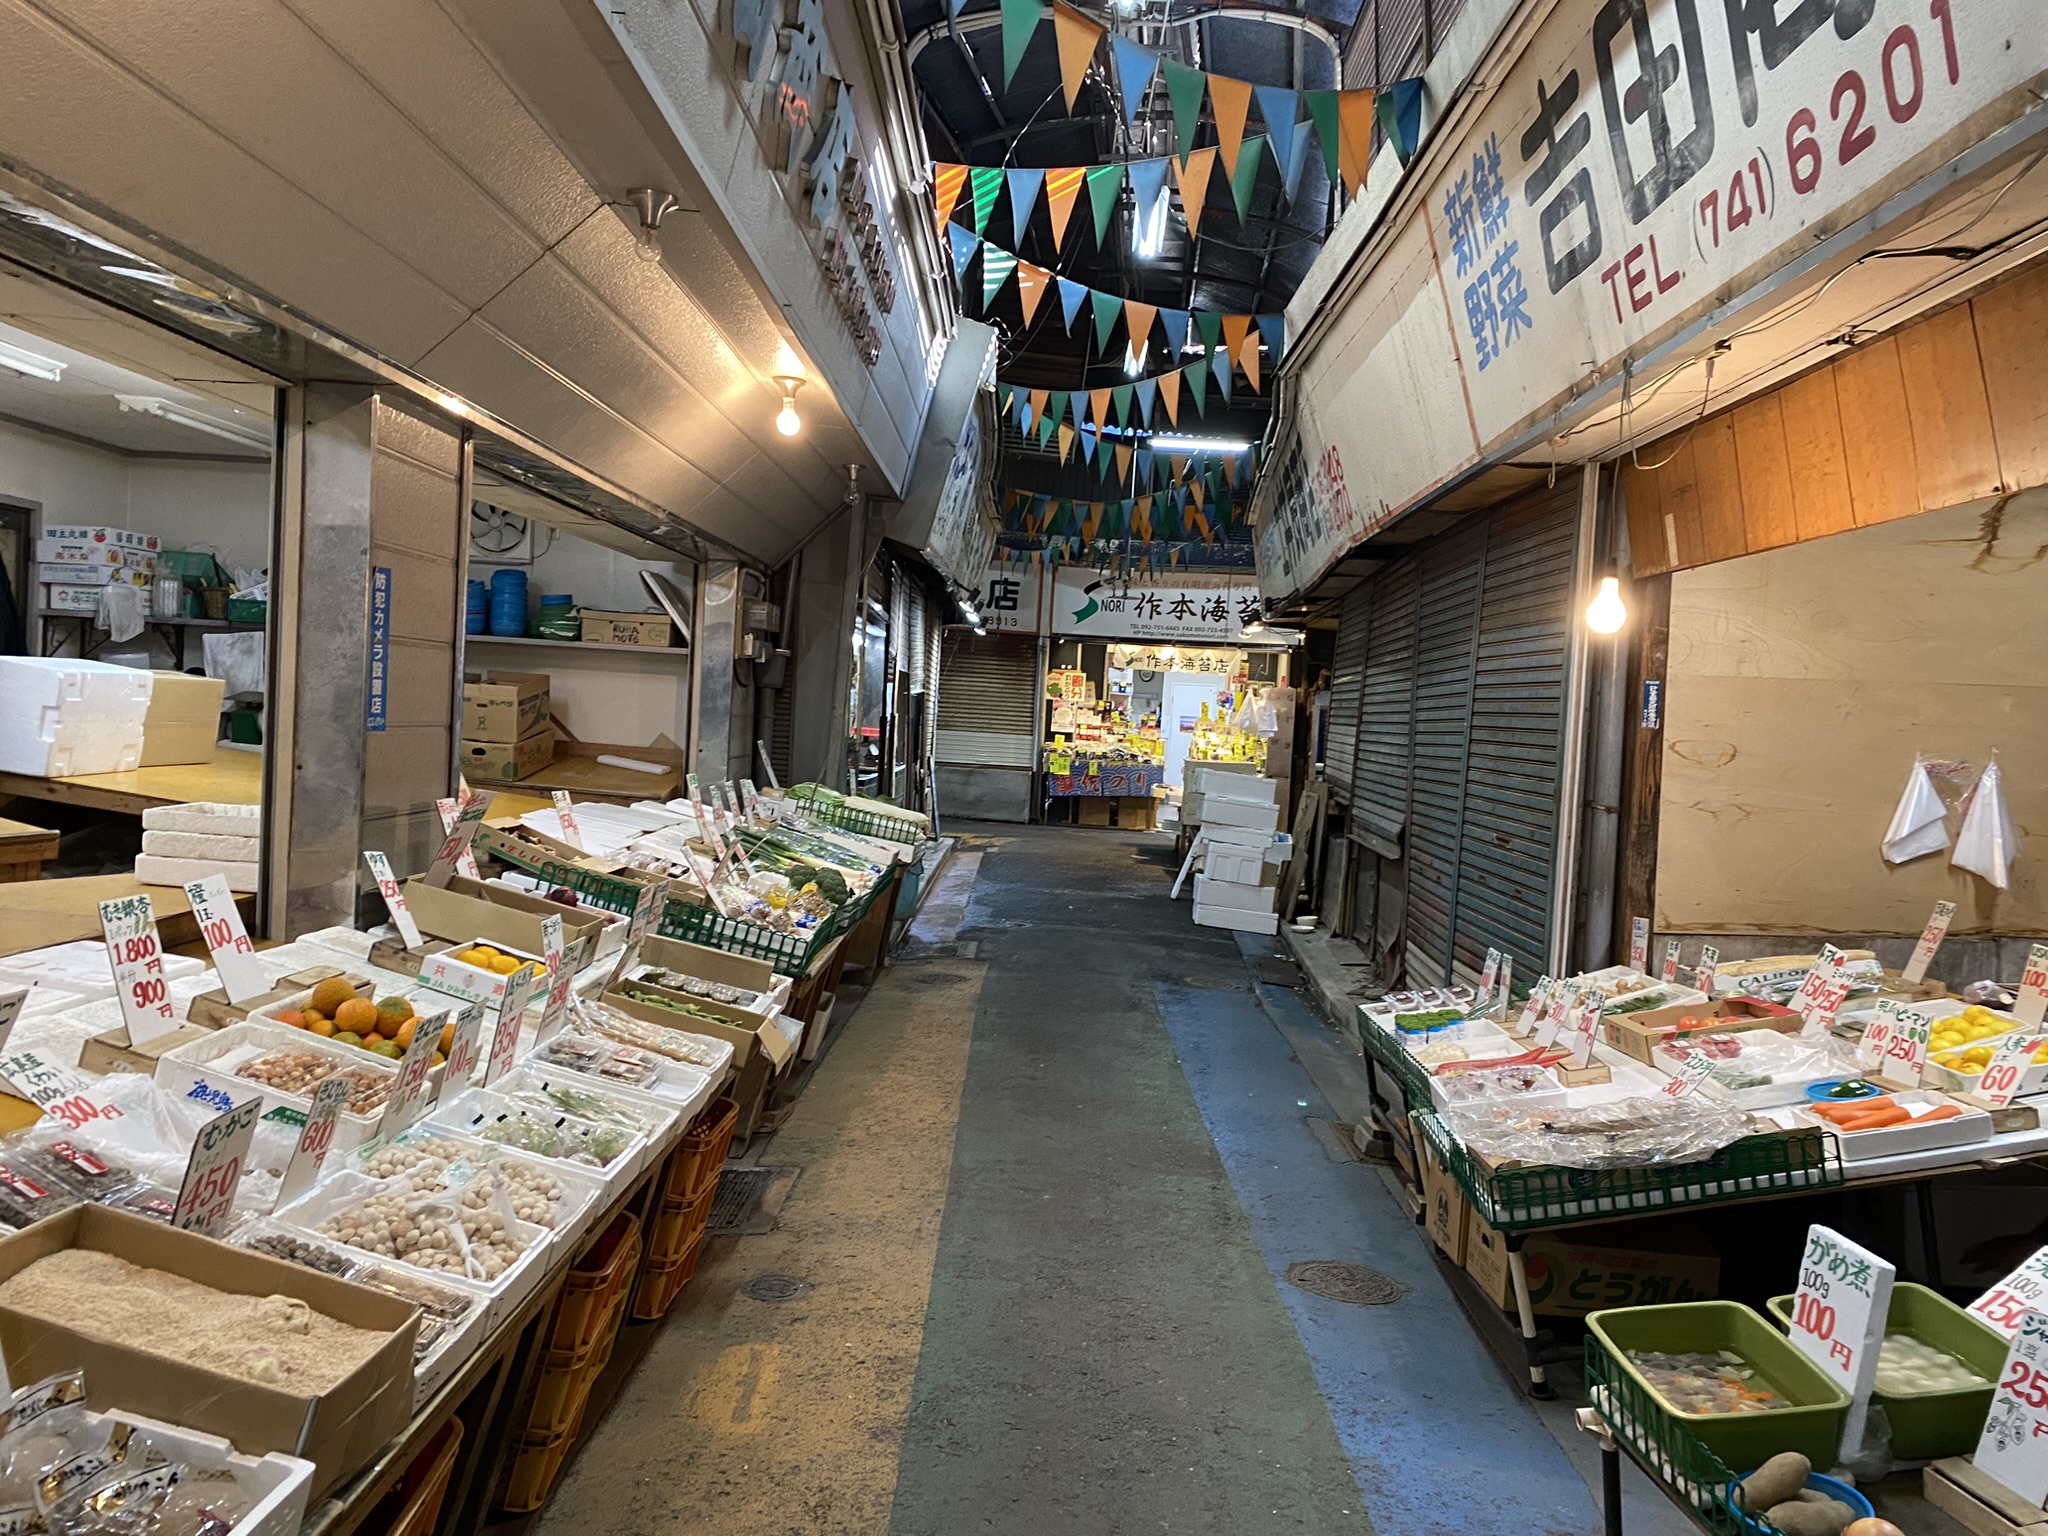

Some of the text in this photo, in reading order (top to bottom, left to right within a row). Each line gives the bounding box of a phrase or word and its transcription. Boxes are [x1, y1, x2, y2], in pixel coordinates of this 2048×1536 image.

[1443, 131, 1510, 279] 新鮮
[1464, 240, 1533, 373] 野菜
[986, 577, 1020, 611] 店
[1101, 599, 1125, 613] NORI
[371, 573, 386, 713] 防犯カメラ設置店
[1146, 653, 1229, 674] 作本海苔店
[1801, 1267, 1830, 1299] 100g
[1806, 1235, 1873, 1299] がめ煮
[2003, 1274, 2043, 1299] 100g
